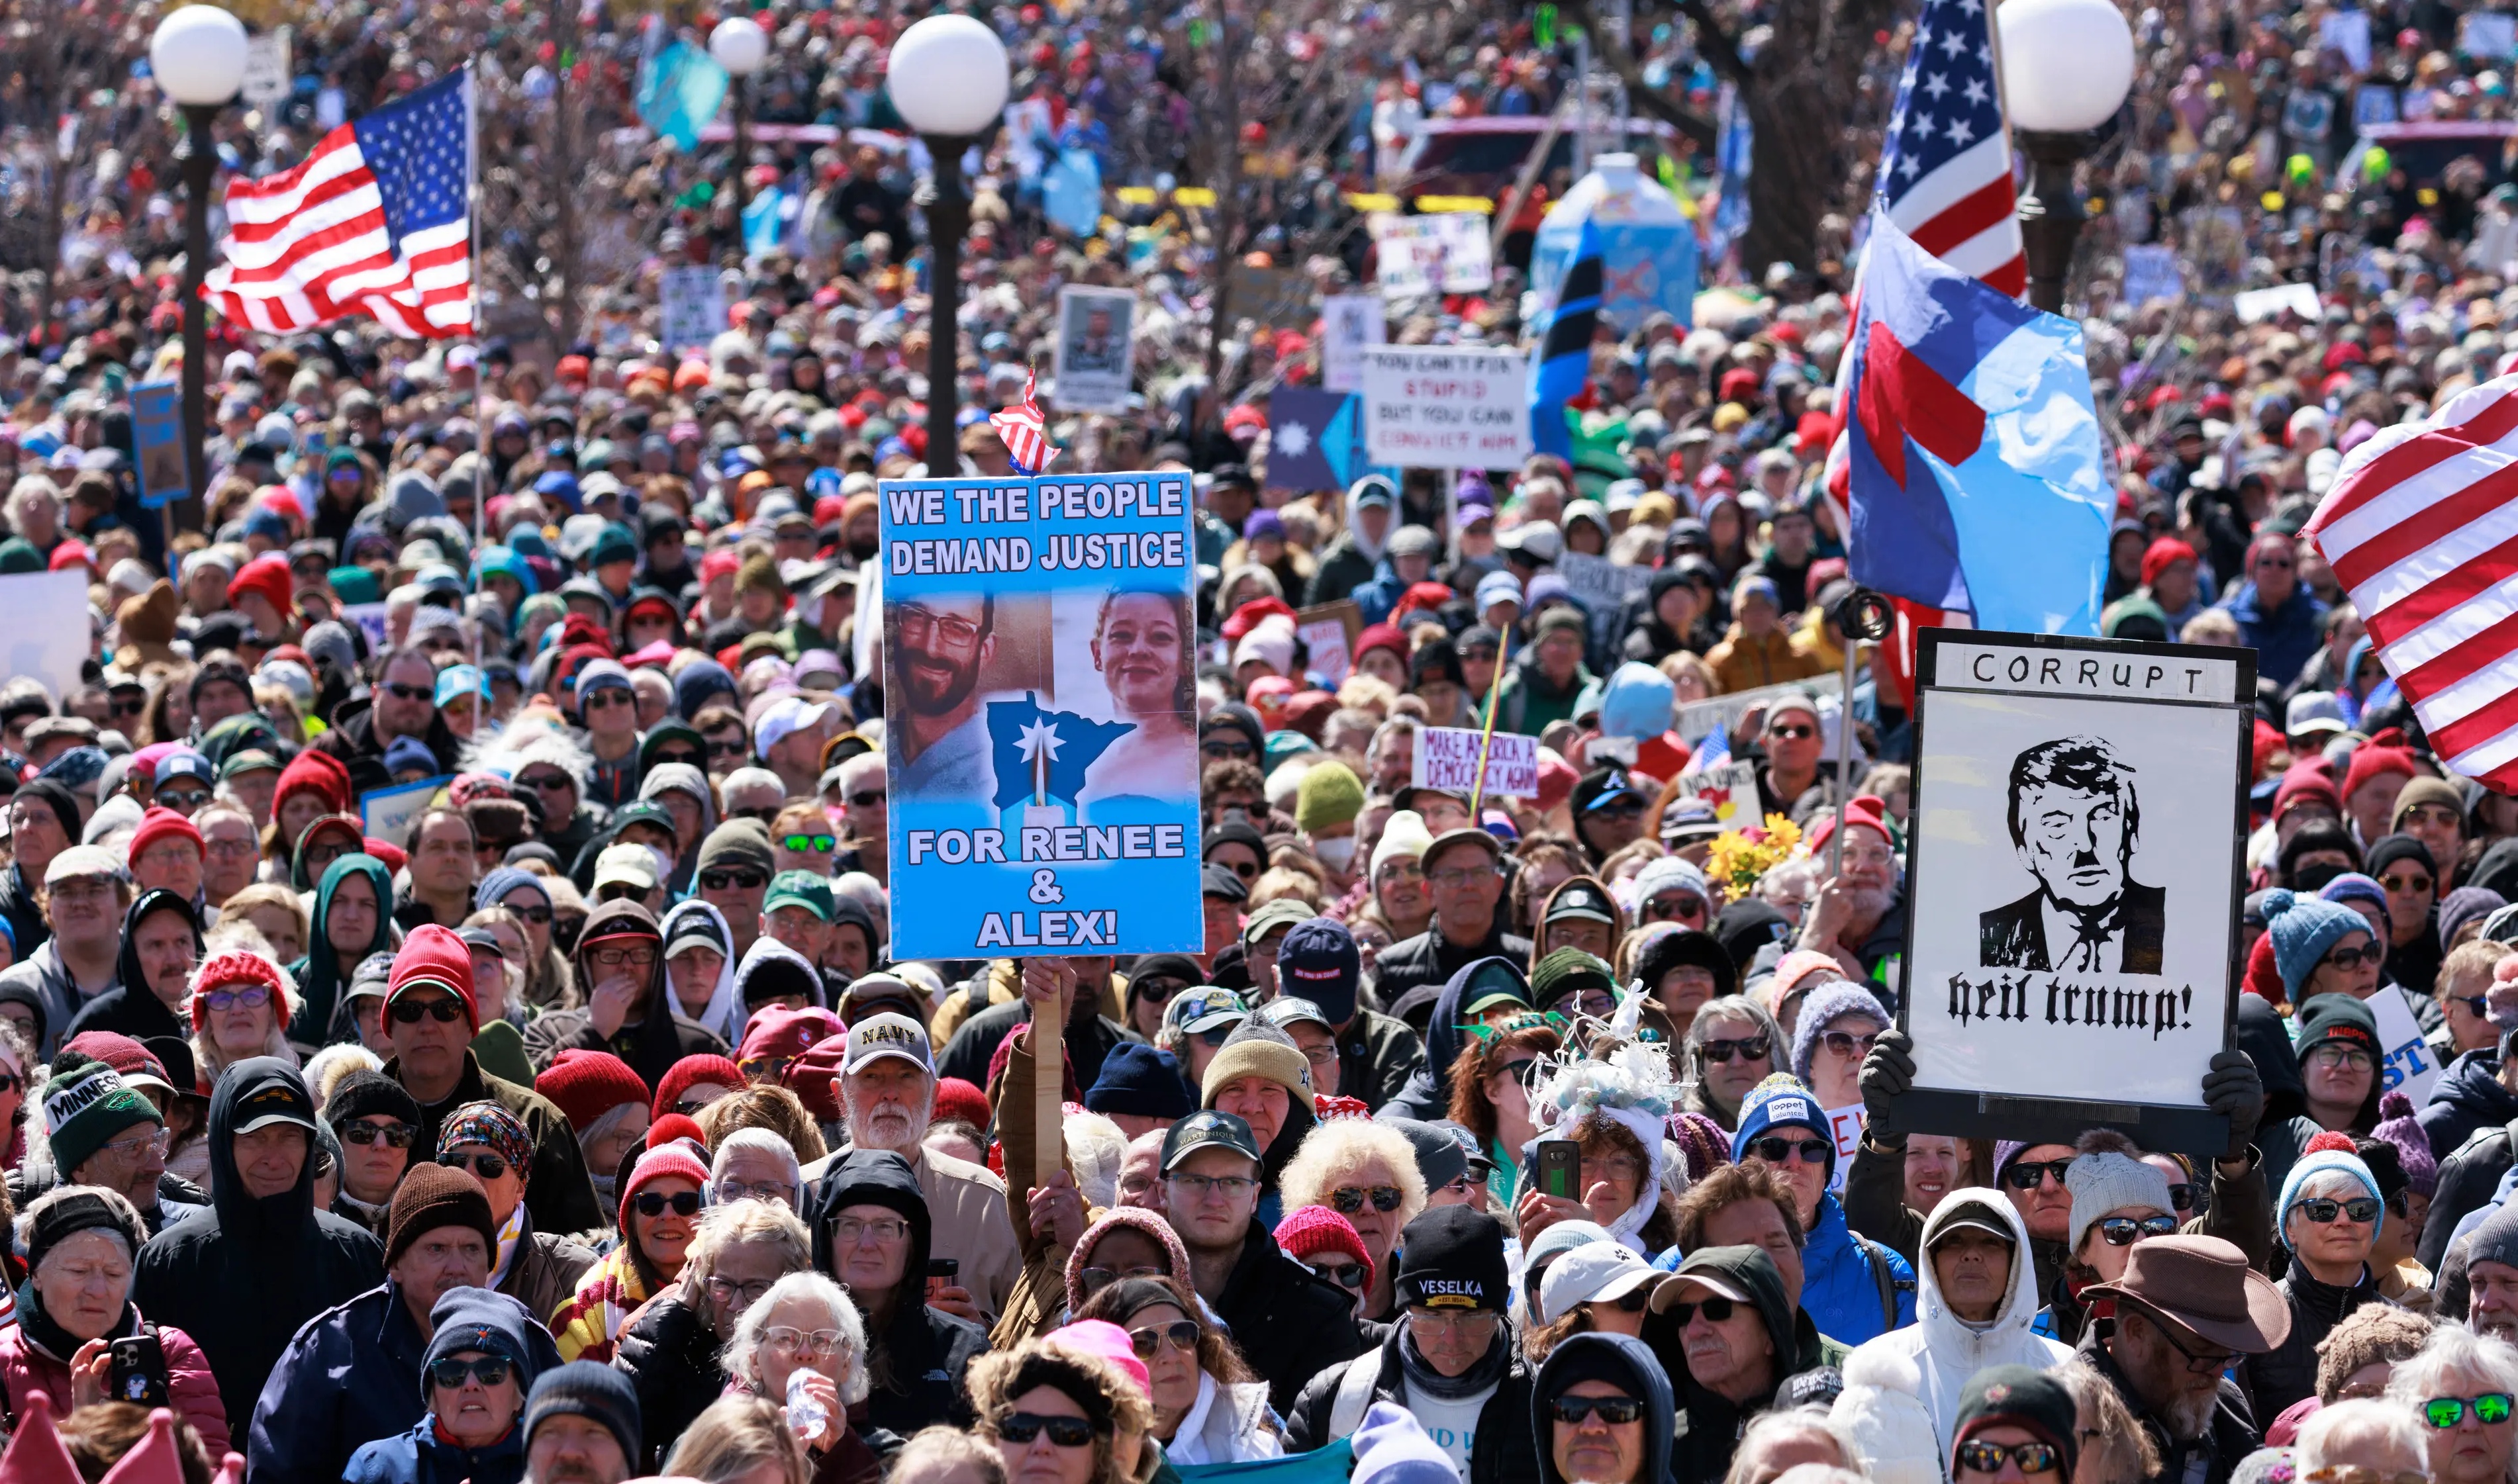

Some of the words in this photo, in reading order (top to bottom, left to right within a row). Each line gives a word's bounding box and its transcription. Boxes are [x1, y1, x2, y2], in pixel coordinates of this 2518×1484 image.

[1404, 379, 1486, 400] STUPID
[1379, 403, 1412, 422] BUT
[1422, 405, 1463, 424] YOU
[1469, 406, 1514, 426] CAN
[888, 488, 945, 525] WE
[954, 487, 1030, 523] THE
[1039, 481, 1183, 520] PEOPLE
[891, 536, 1032, 575] DEMAND
[1039, 532, 1184, 571] JUSTICE
[1973, 654, 2202, 693] CORRUPT
[1426, 731, 1462, 759] MAKE
[1527, 739, 1535, 765] A
[1428, 761, 1502, 789] DEMOCRCY
[908, 828, 1008, 865] FOR
[1020, 824, 1185, 862] RENEE
[1028, 868, 1065, 904] &
[975, 909, 1118, 948] ALEX!
[2045, 976, 2192, 1041] trump!
[862, 1023, 917, 1045] NAVY
[1771, 1101, 1802, 1112] loppet
[1180, 1131, 1236, 1146] MARTINIQUE
[1419, 1280, 1483, 1296] VESELKA
